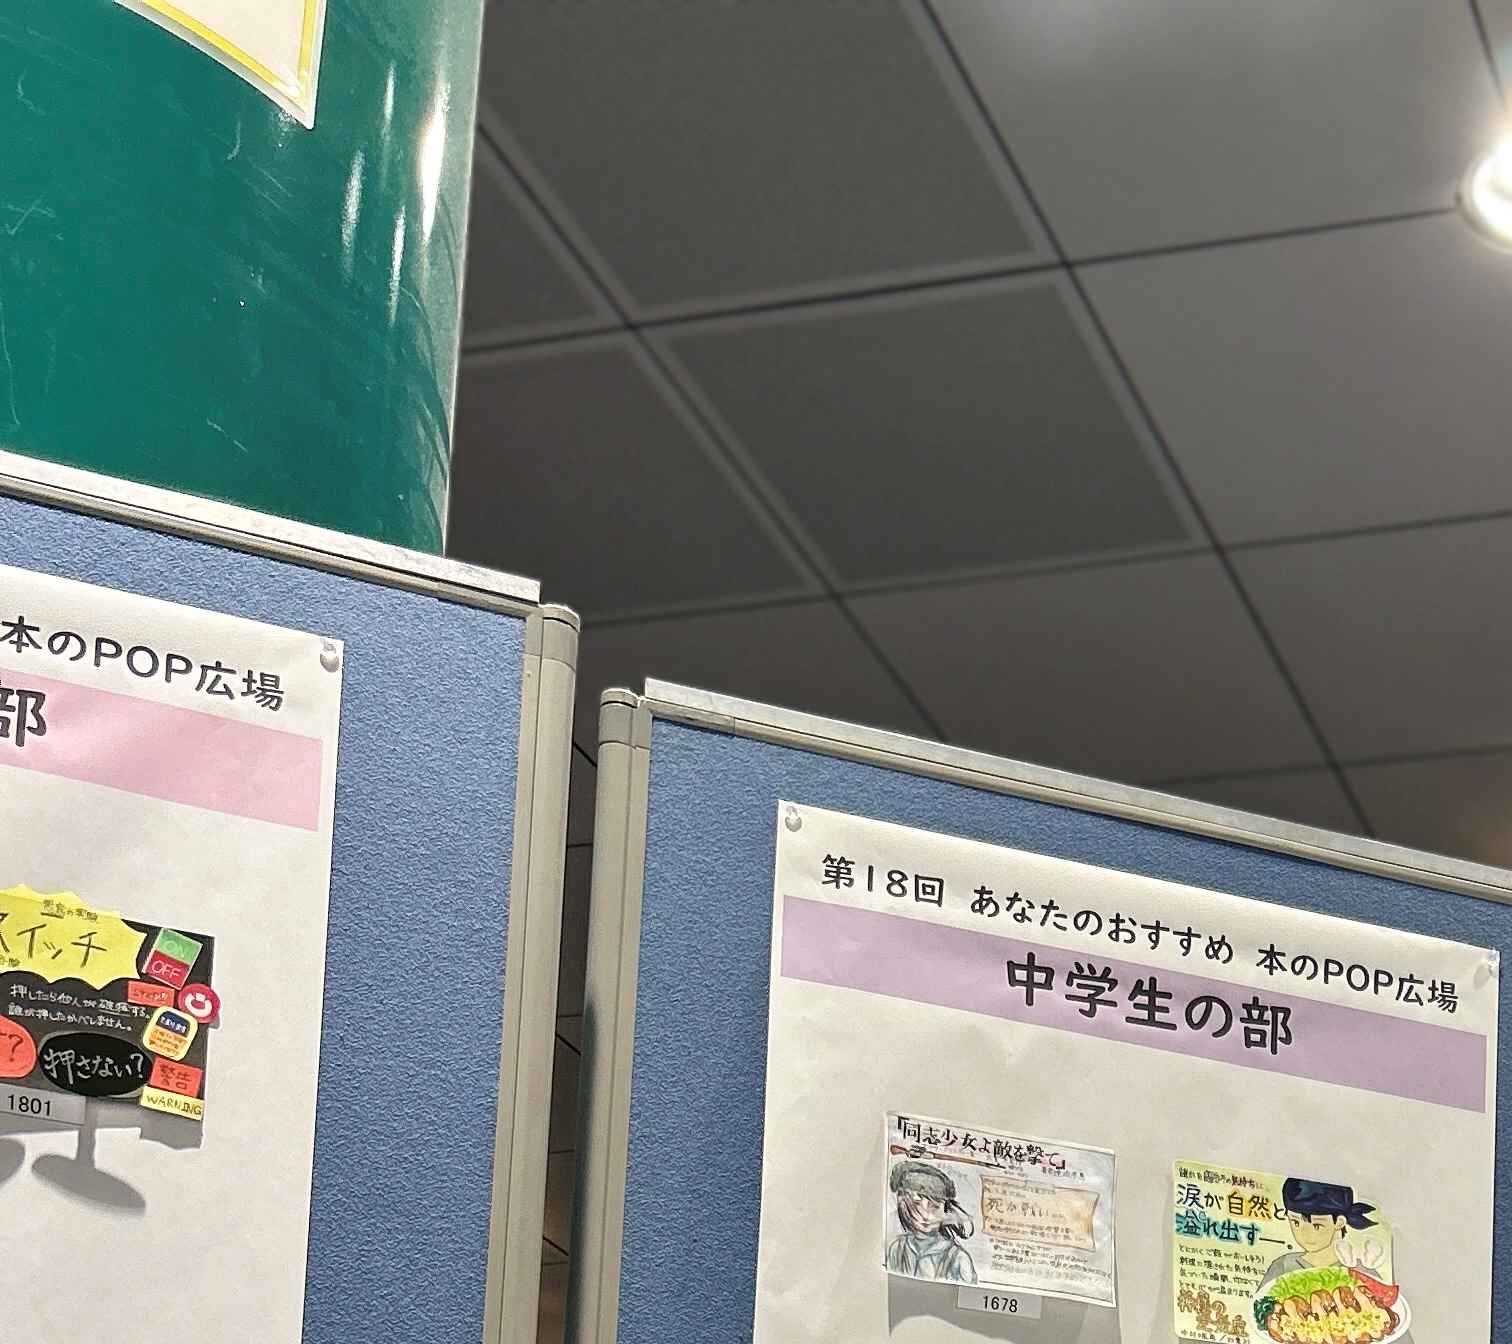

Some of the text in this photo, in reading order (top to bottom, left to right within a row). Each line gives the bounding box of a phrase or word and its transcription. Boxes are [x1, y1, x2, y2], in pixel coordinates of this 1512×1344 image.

[1, 616, 285, 711] 本のPOP広場
[821, 852, 1460, 1015] 第18回 あなたのおすすめ 本のPOP広場
[152, 959, 181, 979] OFF
[1005, 952, 1295, 1055] 中学生の部
[8, 1094, 51, 1117] 1801
[146, 1092, 202, 1116] WARNING
[1176, 1183, 1287, 1220] 涙が自然と
[982, 1295, 1018, 1313] 1678
